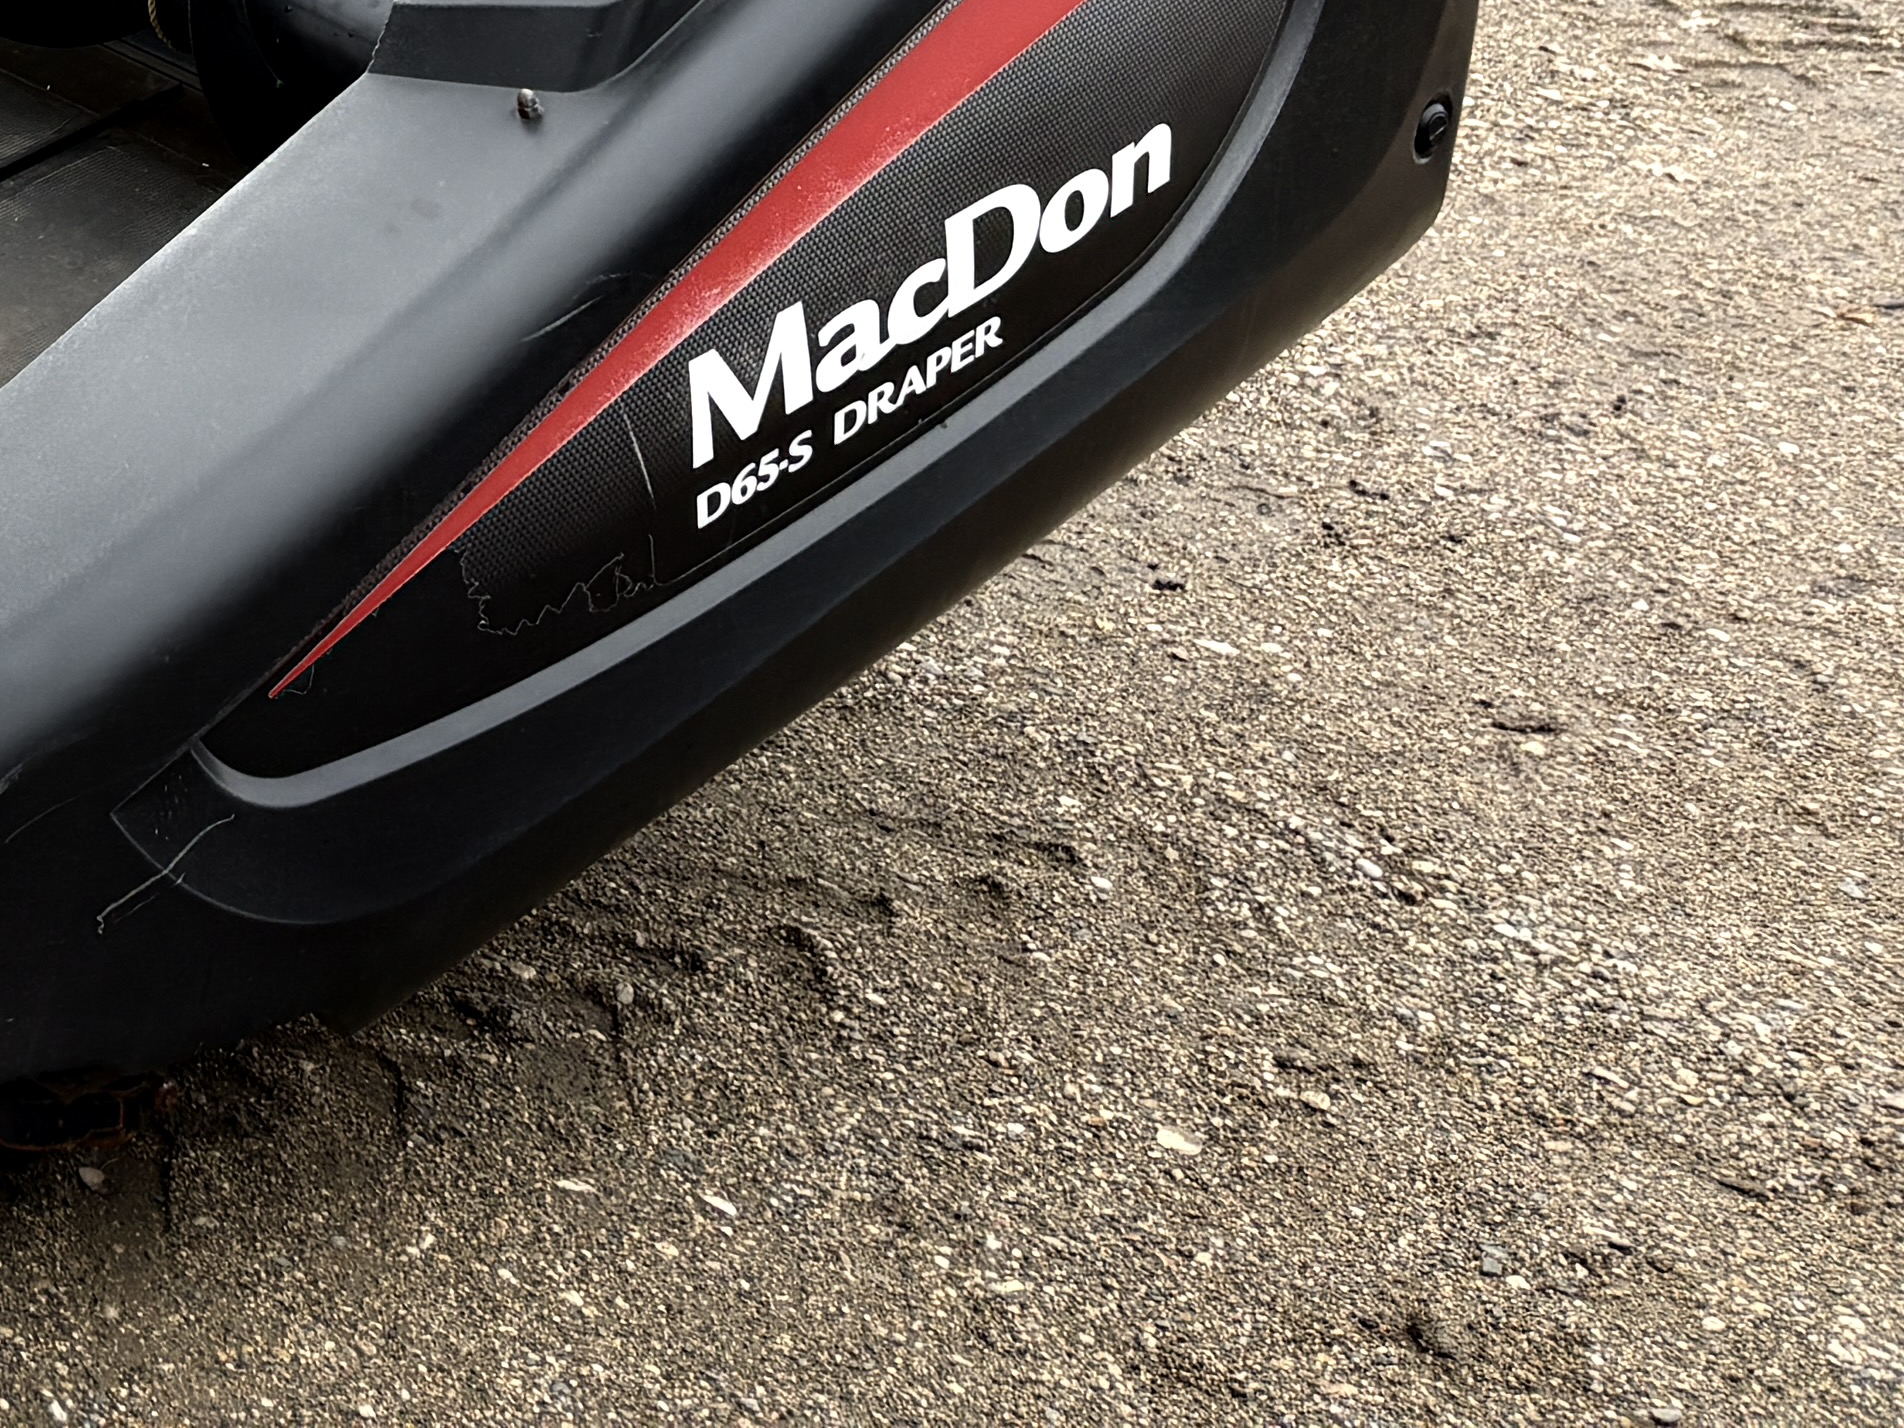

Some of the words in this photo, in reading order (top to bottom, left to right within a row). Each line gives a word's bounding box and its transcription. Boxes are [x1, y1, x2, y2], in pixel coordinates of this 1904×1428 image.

[688, 123, 1172, 469] MacDon
[697, 430, 813, 529] D65-S
[832, 315, 1004, 445] DRAPER
